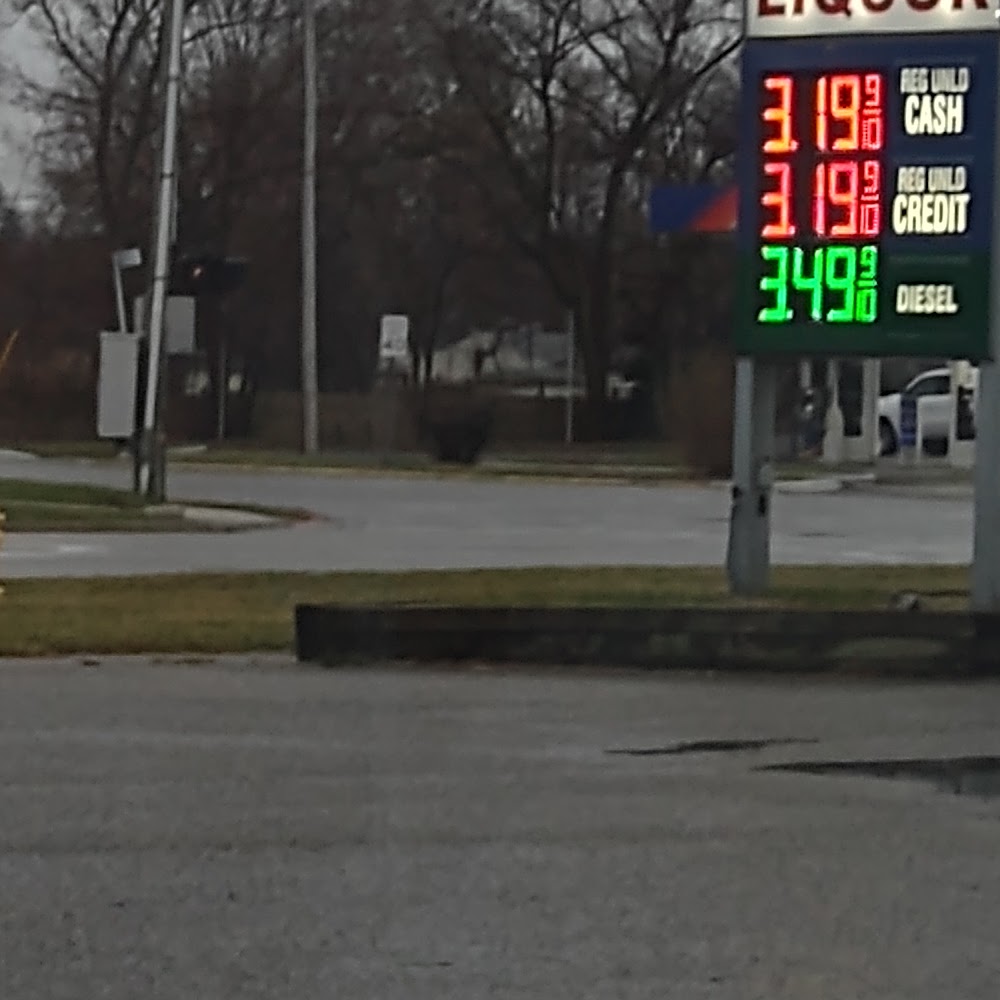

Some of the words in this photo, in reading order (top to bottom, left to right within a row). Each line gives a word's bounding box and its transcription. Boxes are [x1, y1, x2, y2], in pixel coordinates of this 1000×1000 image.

[905, 94, 964, 135] CASH
[892, 194, 970, 235] CREDIT
[895, 283, 958, 314] DIESEL
